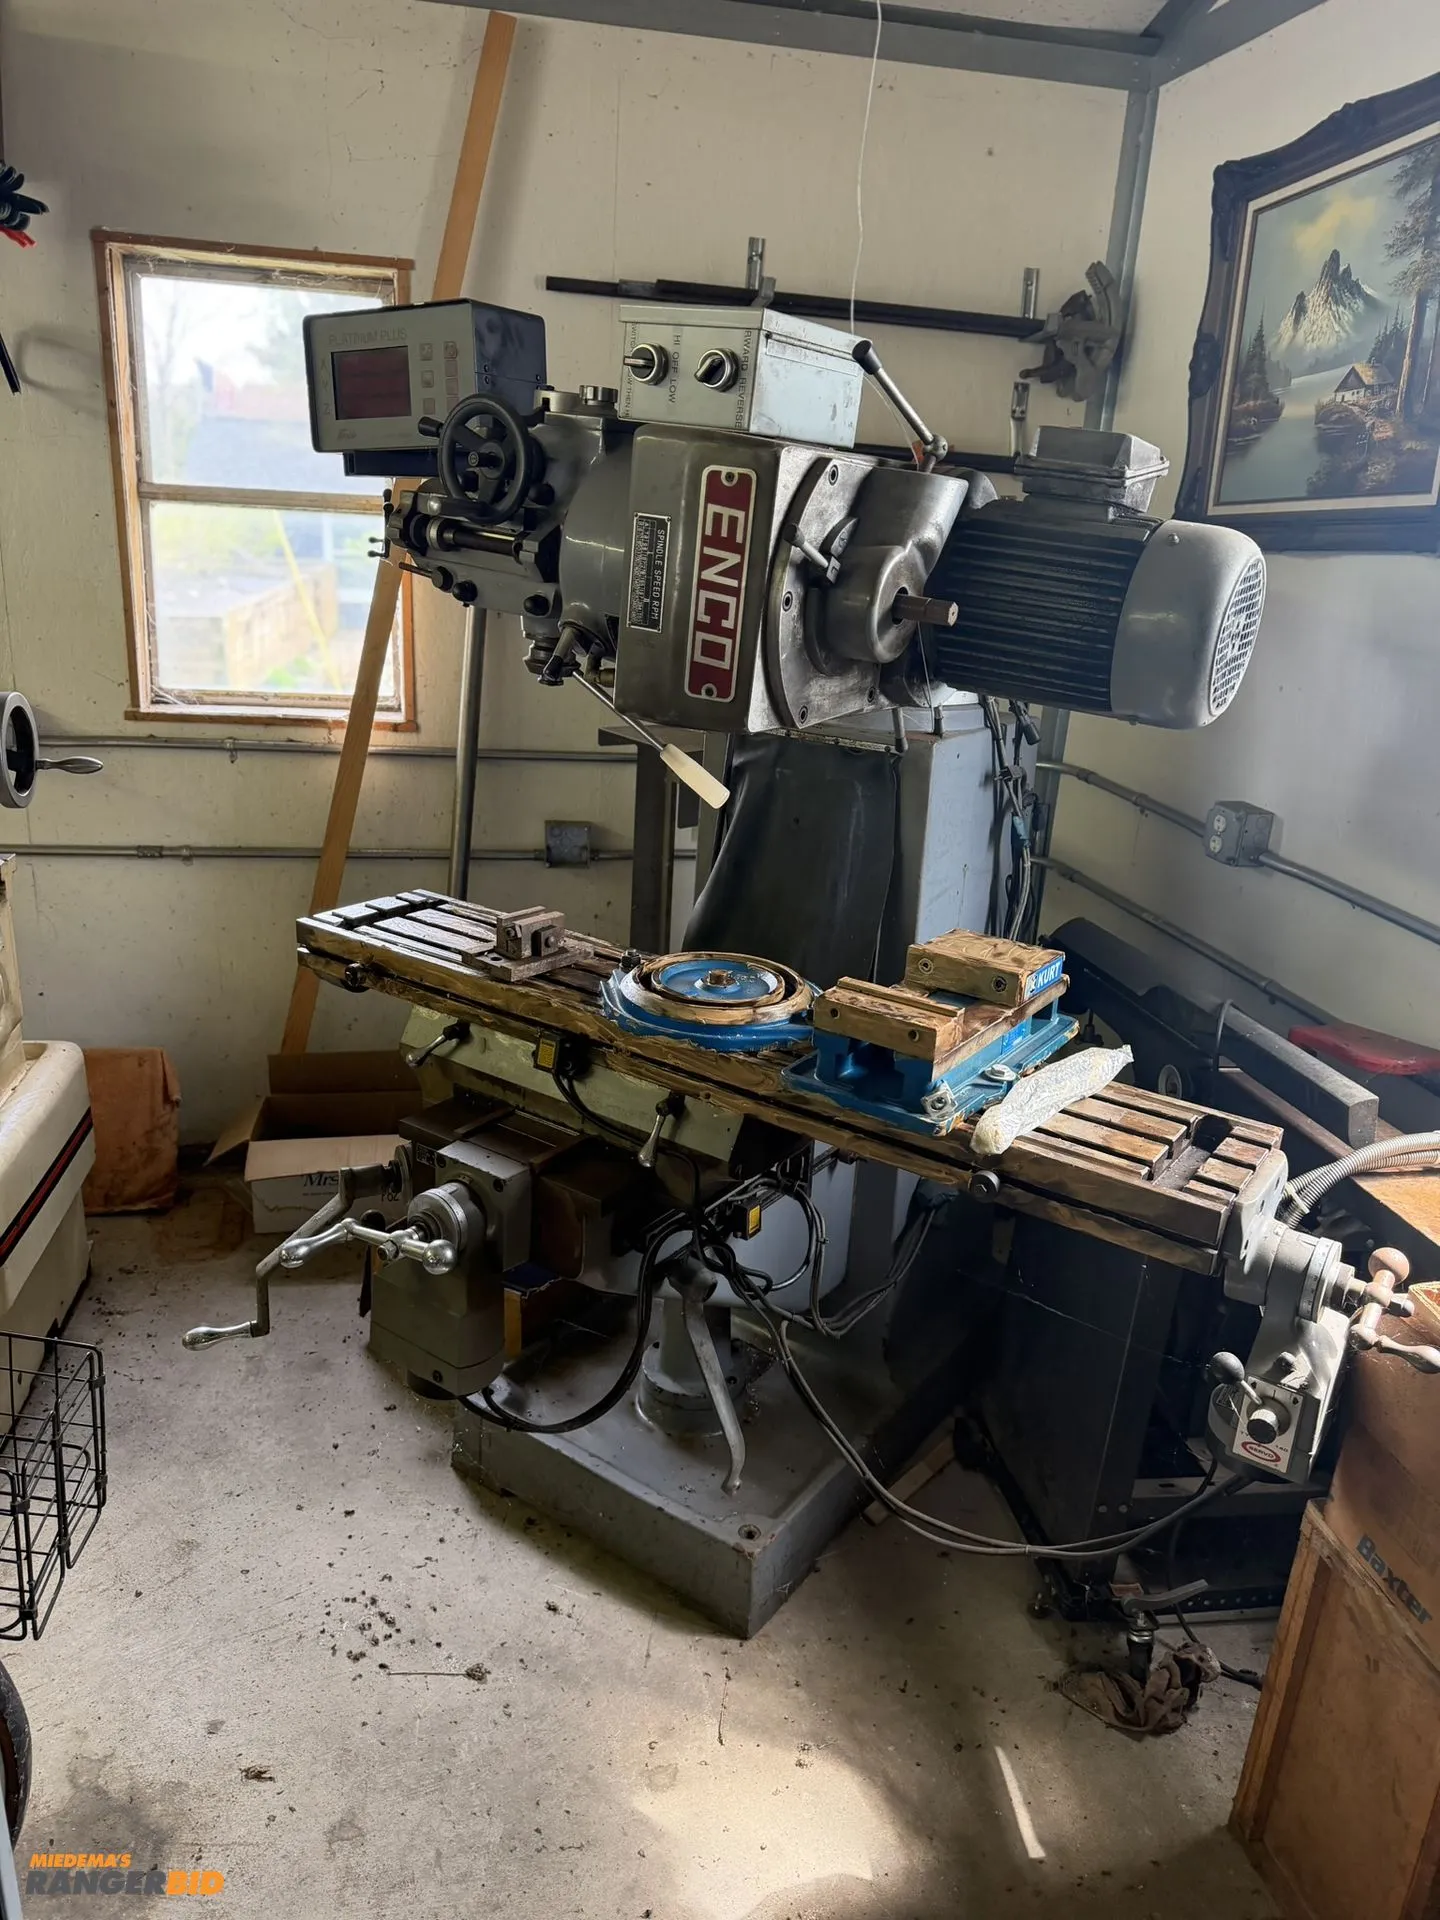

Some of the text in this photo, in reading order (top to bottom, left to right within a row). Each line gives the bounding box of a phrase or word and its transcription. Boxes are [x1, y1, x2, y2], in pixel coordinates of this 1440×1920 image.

[328, 327, 408, 346] PLATINUM PLUS
[668, 334, 681, 403] HI OFF LOW
[734, 377, 748, 429] REVERSE
[650, 528, 665, 620] SPINDLE SPEED RPM
[693, 503, 746, 670] ENCO
[1037, 961, 1061, 987] KURT
[1248, 1445, 1275, 1459] SERVO
[1356, 1533, 1433, 1624] Baxter
